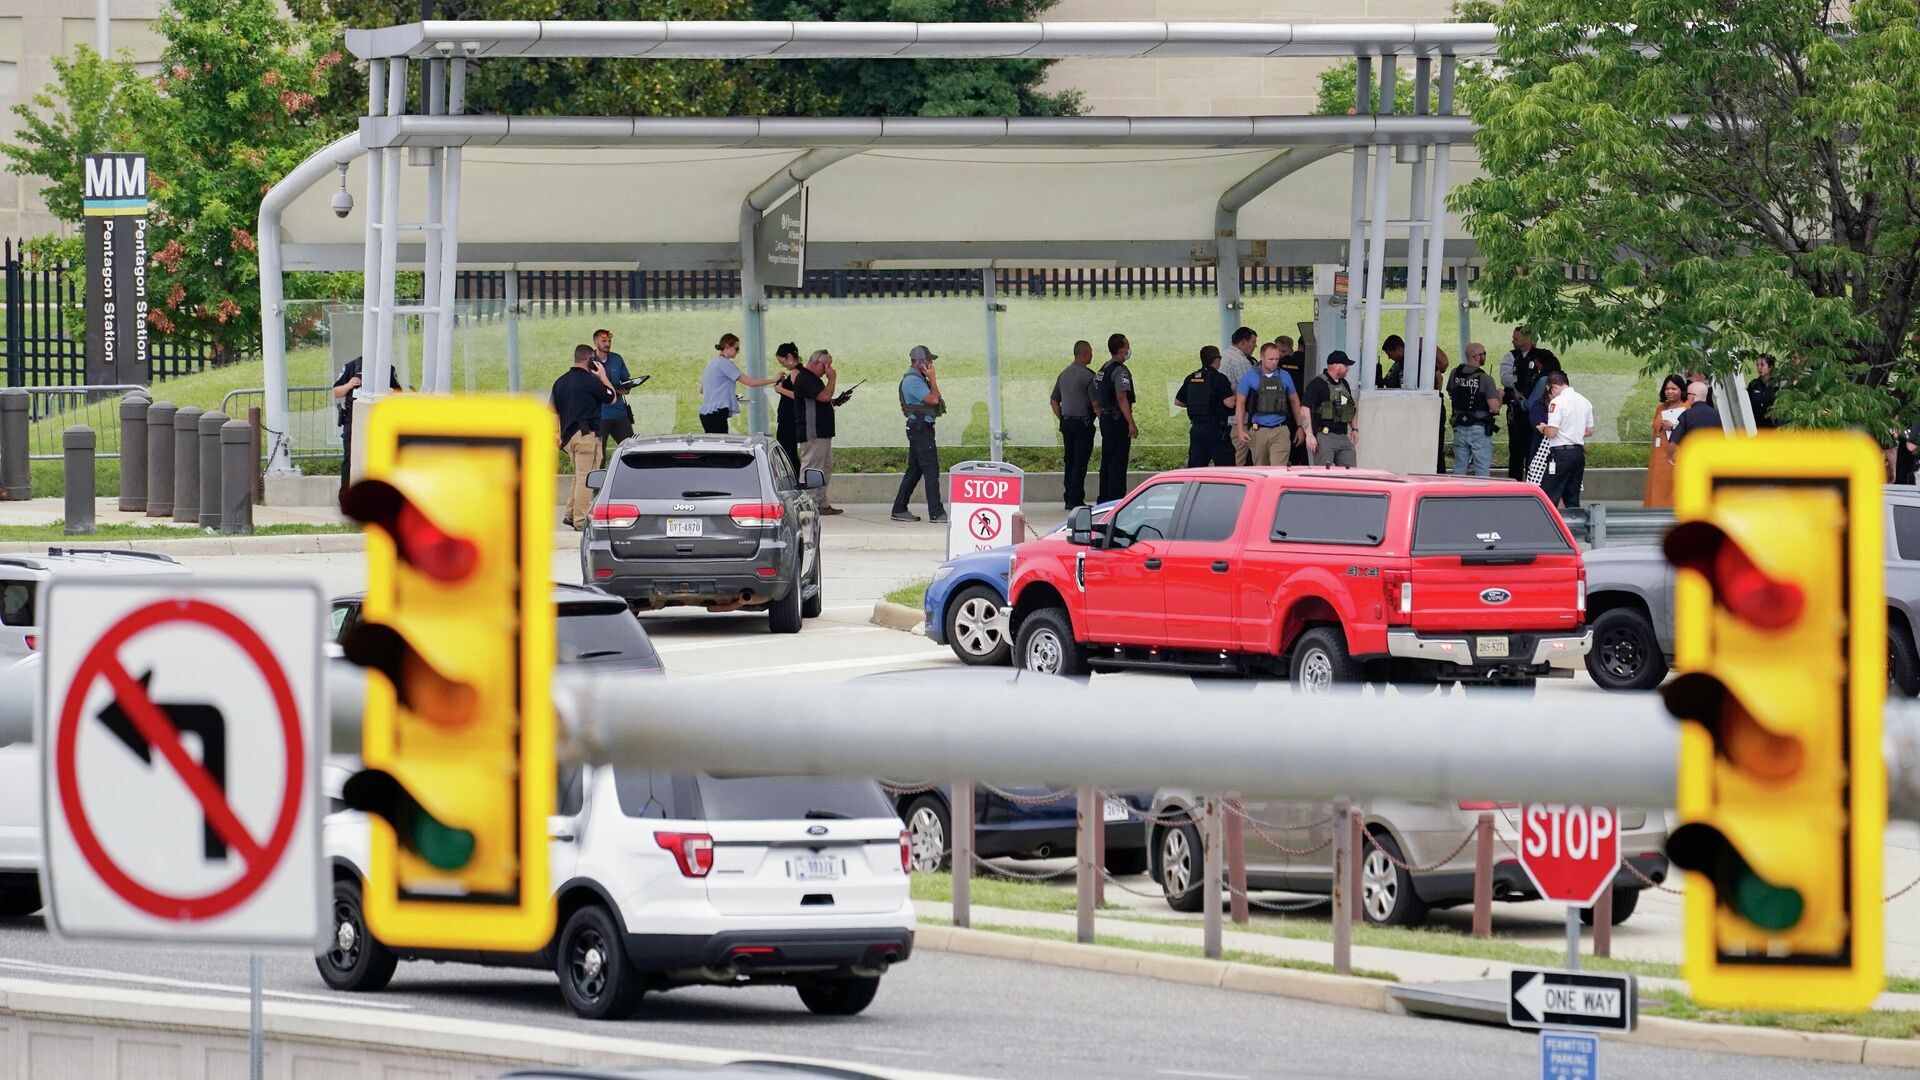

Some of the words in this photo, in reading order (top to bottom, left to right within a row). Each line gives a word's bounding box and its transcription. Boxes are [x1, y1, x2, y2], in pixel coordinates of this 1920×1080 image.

[102, 220, 114, 298] Pentagon
[134, 219, 147, 297] Pentagon
[104, 302, 115, 361] Station
[136, 301, 148, 361] Station
[1455, 378, 1479, 388] POLICE
[964, 480, 1009, 499] STOP
[673, 502, 695, 511] Jeep
[1484, 590, 1507, 602] Ford
[1526, 803, 1613, 860] STOP
[1545, 989, 1577, 1011] ONE
[1583, 991, 1615, 1013] WAY
[1545, 1038, 1594, 1054] PERMITTED
[1550, 1052, 1589, 1067] PARKING
